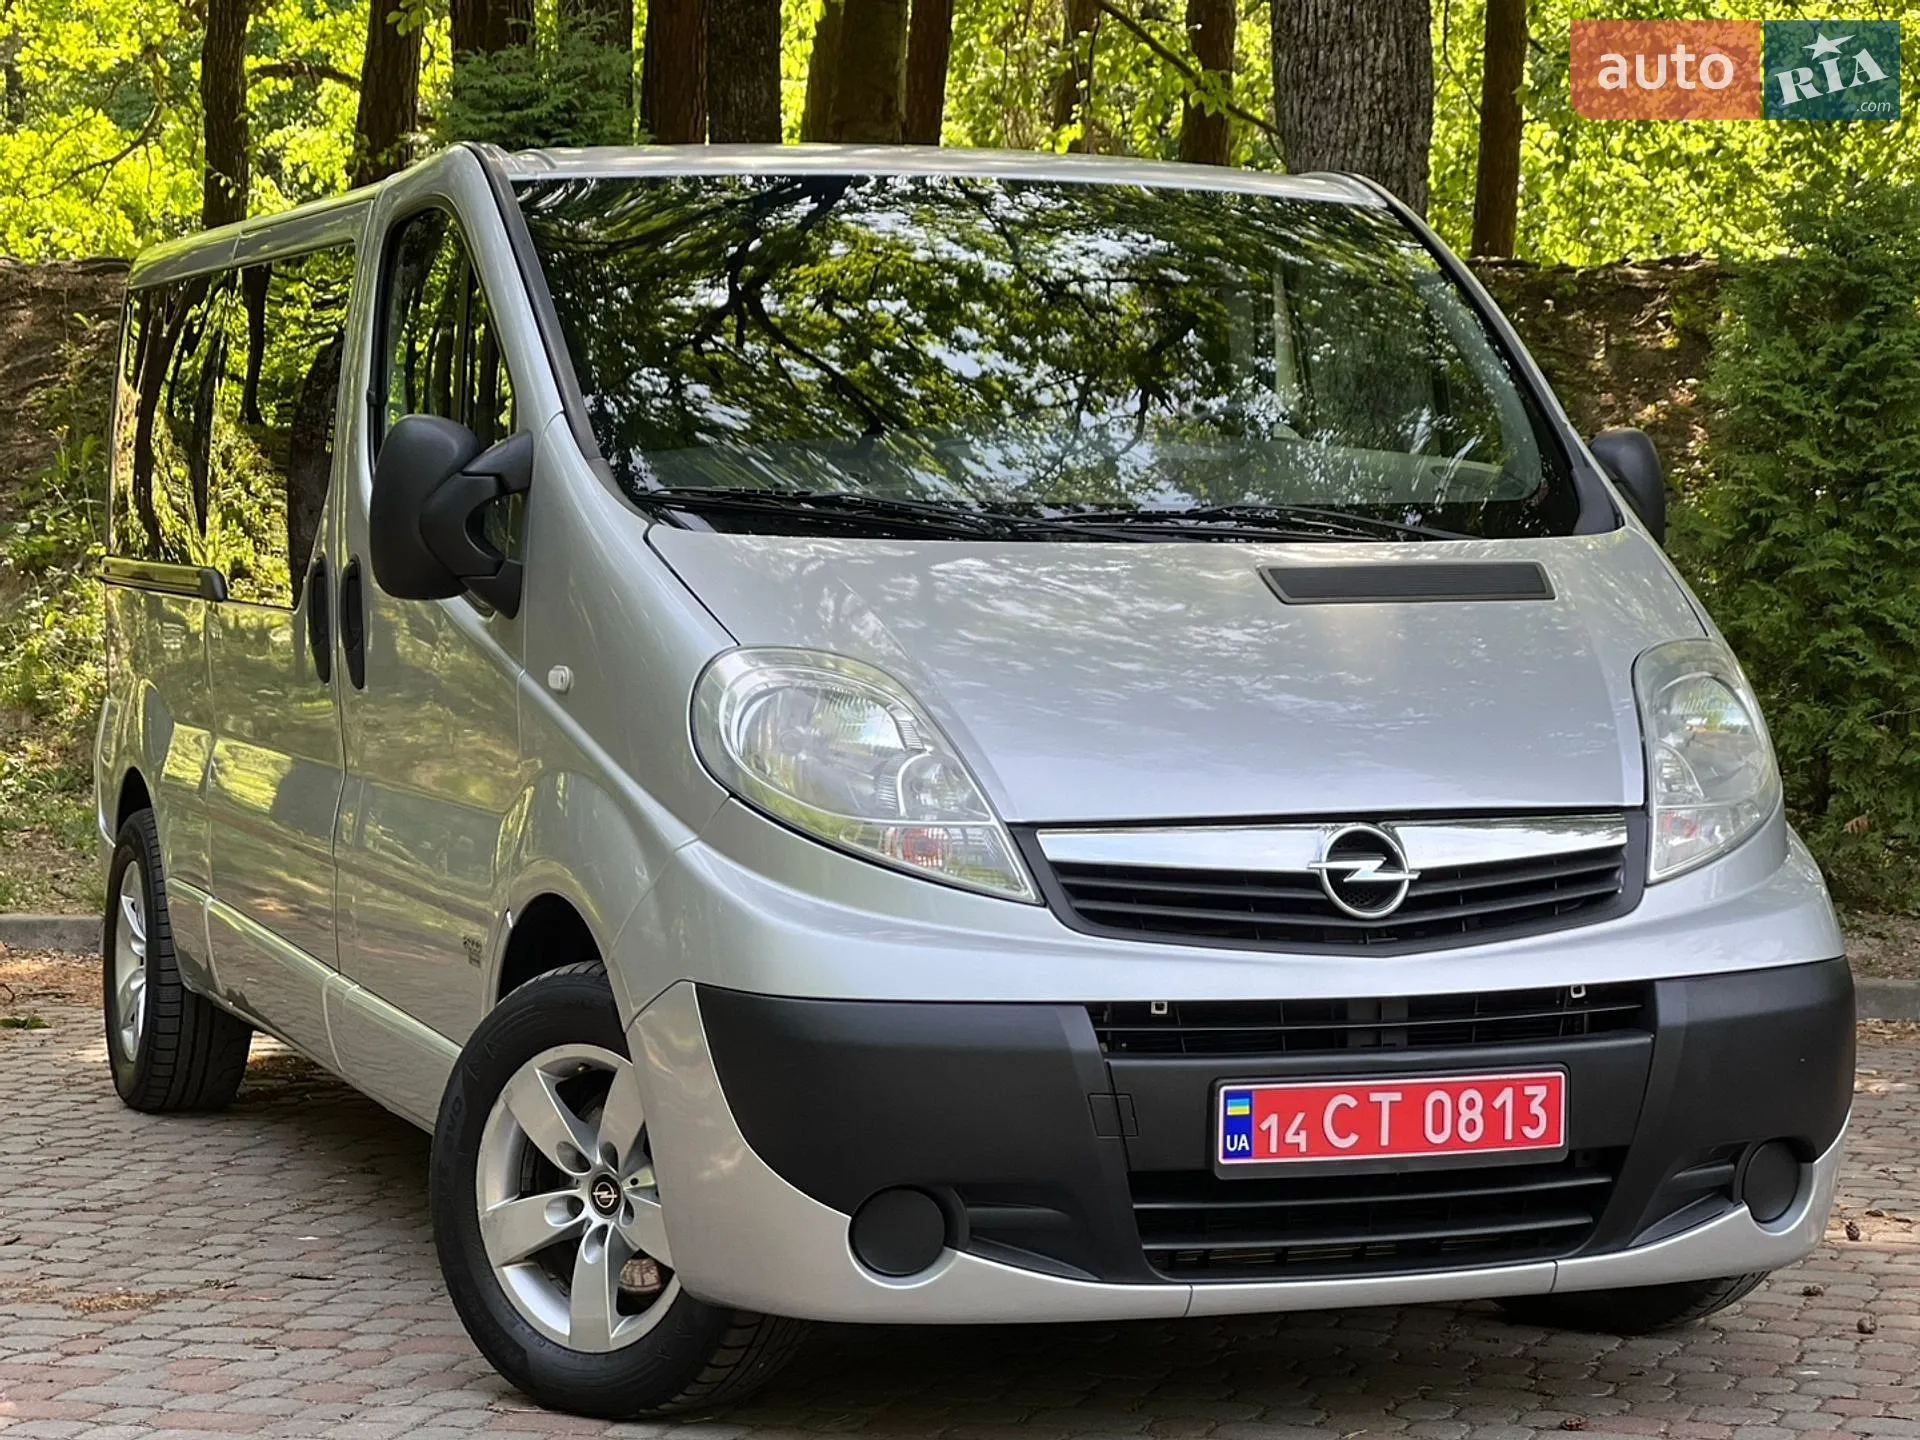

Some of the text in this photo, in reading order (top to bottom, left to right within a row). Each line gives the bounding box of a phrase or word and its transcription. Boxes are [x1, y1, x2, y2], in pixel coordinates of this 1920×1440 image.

[1259, 1085, 1548, 1153] 14 CT 0813
[1226, 1134, 1250, 1152] UA
